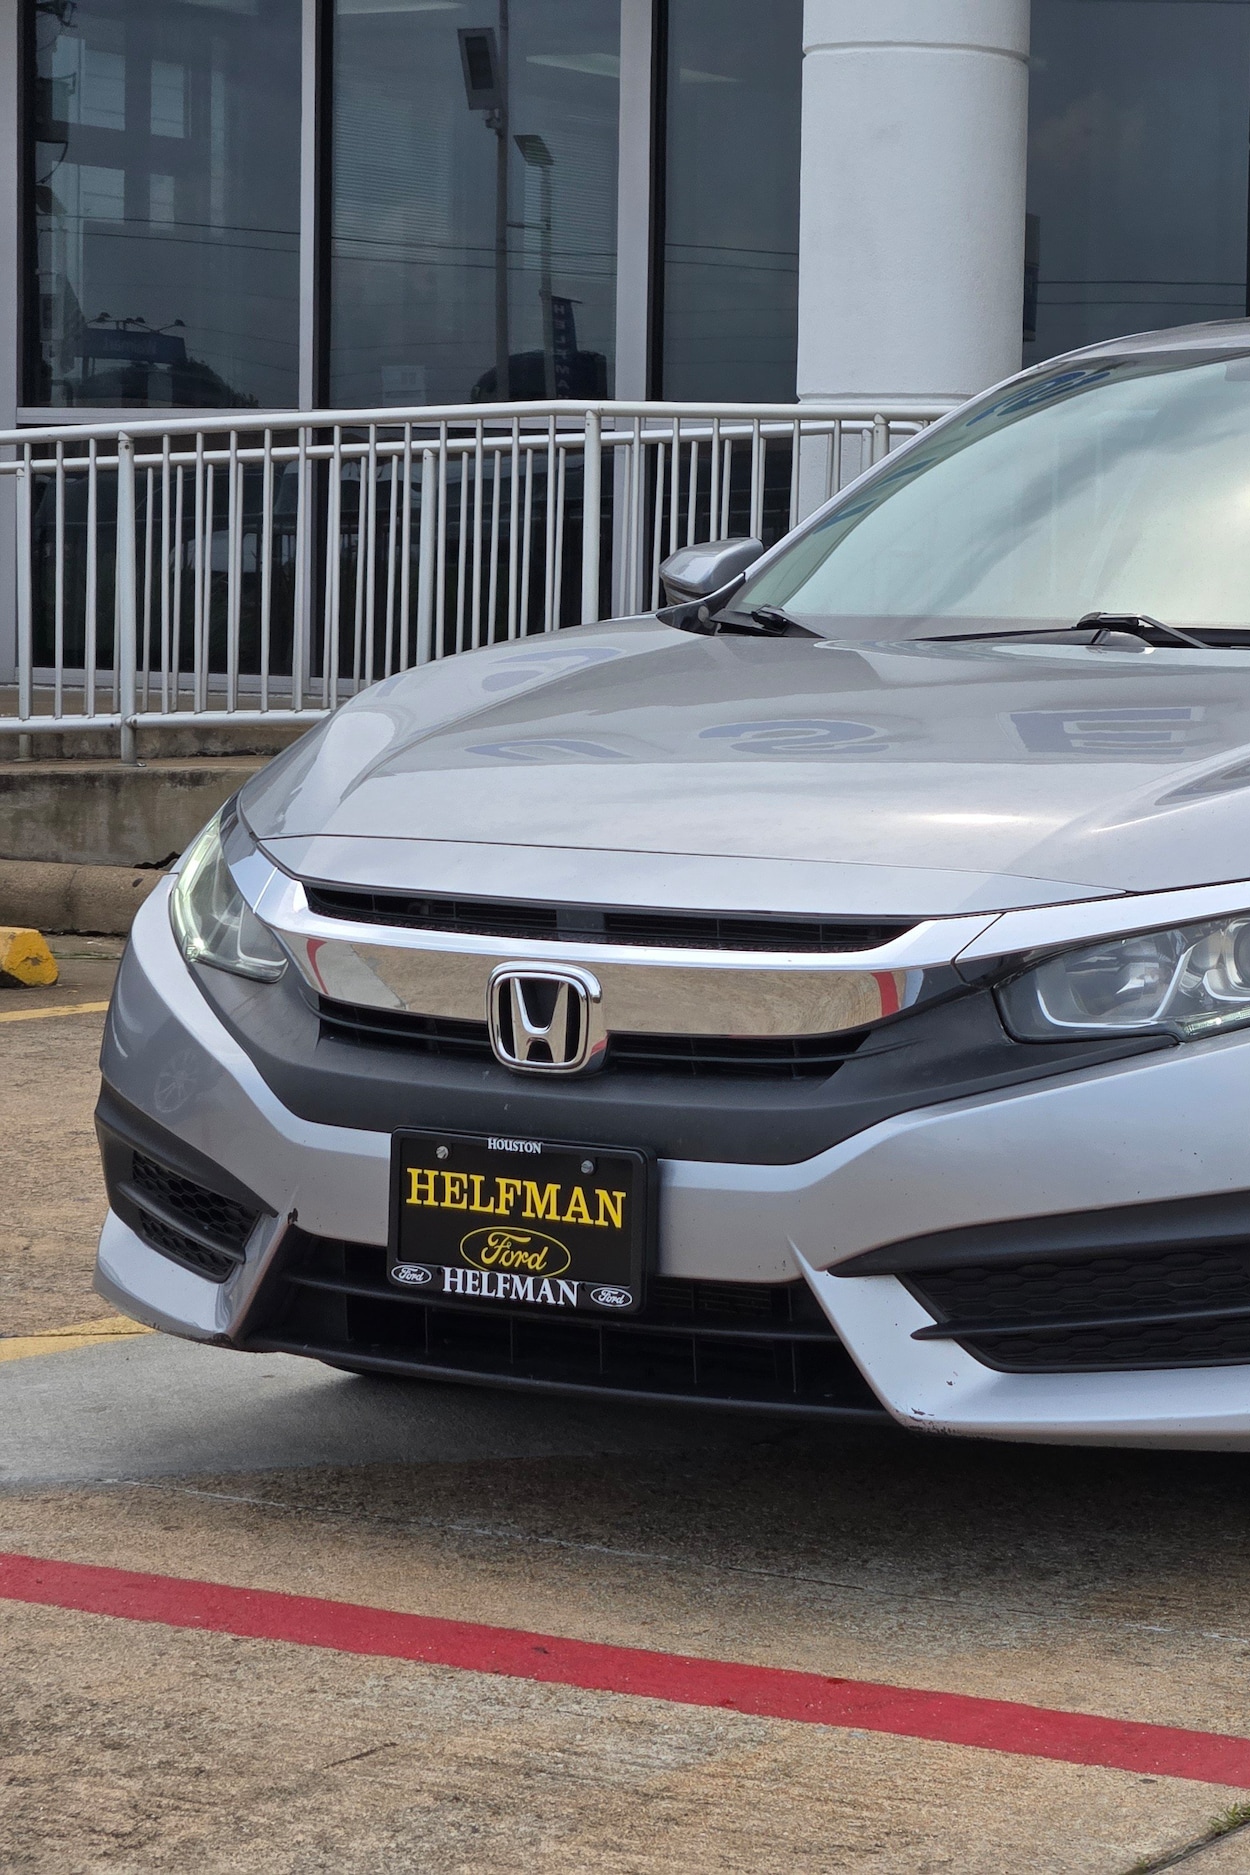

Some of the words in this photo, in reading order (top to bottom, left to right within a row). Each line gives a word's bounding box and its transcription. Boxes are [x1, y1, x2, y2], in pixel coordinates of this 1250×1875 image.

[487, 1137, 542, 1155] HOUSTON
[406, 1167, 626, 1229] HELFMAN
[480, 1231, 550, 1271] Ford
[398, 1267, 424, 1281] Ford
[442, 1267, 579, 1308] HELFMAN
[598, 1289, 625, 1304] Ford
